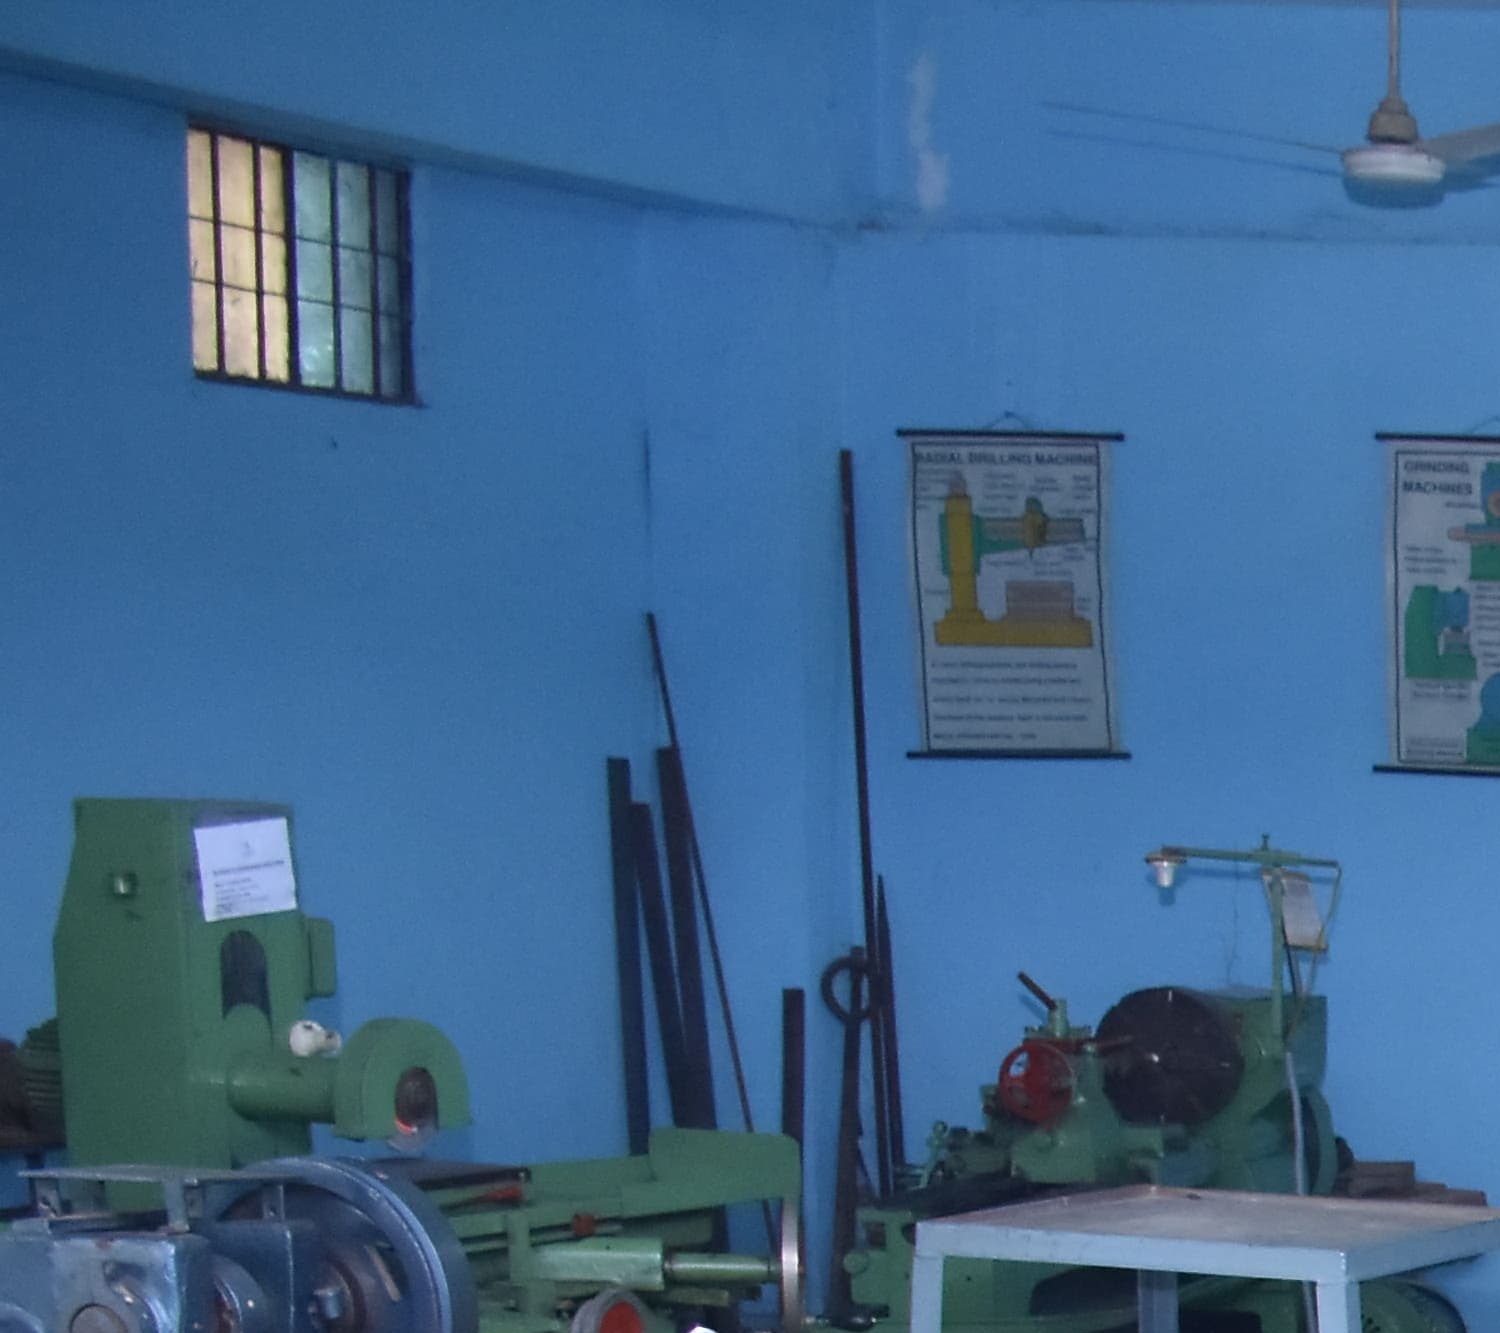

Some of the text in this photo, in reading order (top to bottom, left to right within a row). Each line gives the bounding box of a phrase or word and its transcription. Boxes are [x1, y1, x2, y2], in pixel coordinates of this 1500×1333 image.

[1034, 452, 1096, 466] MACHINE
[1403, 460, 1470, 474] GRINDING
[1402, 481, 1473, 496] MACHINES
